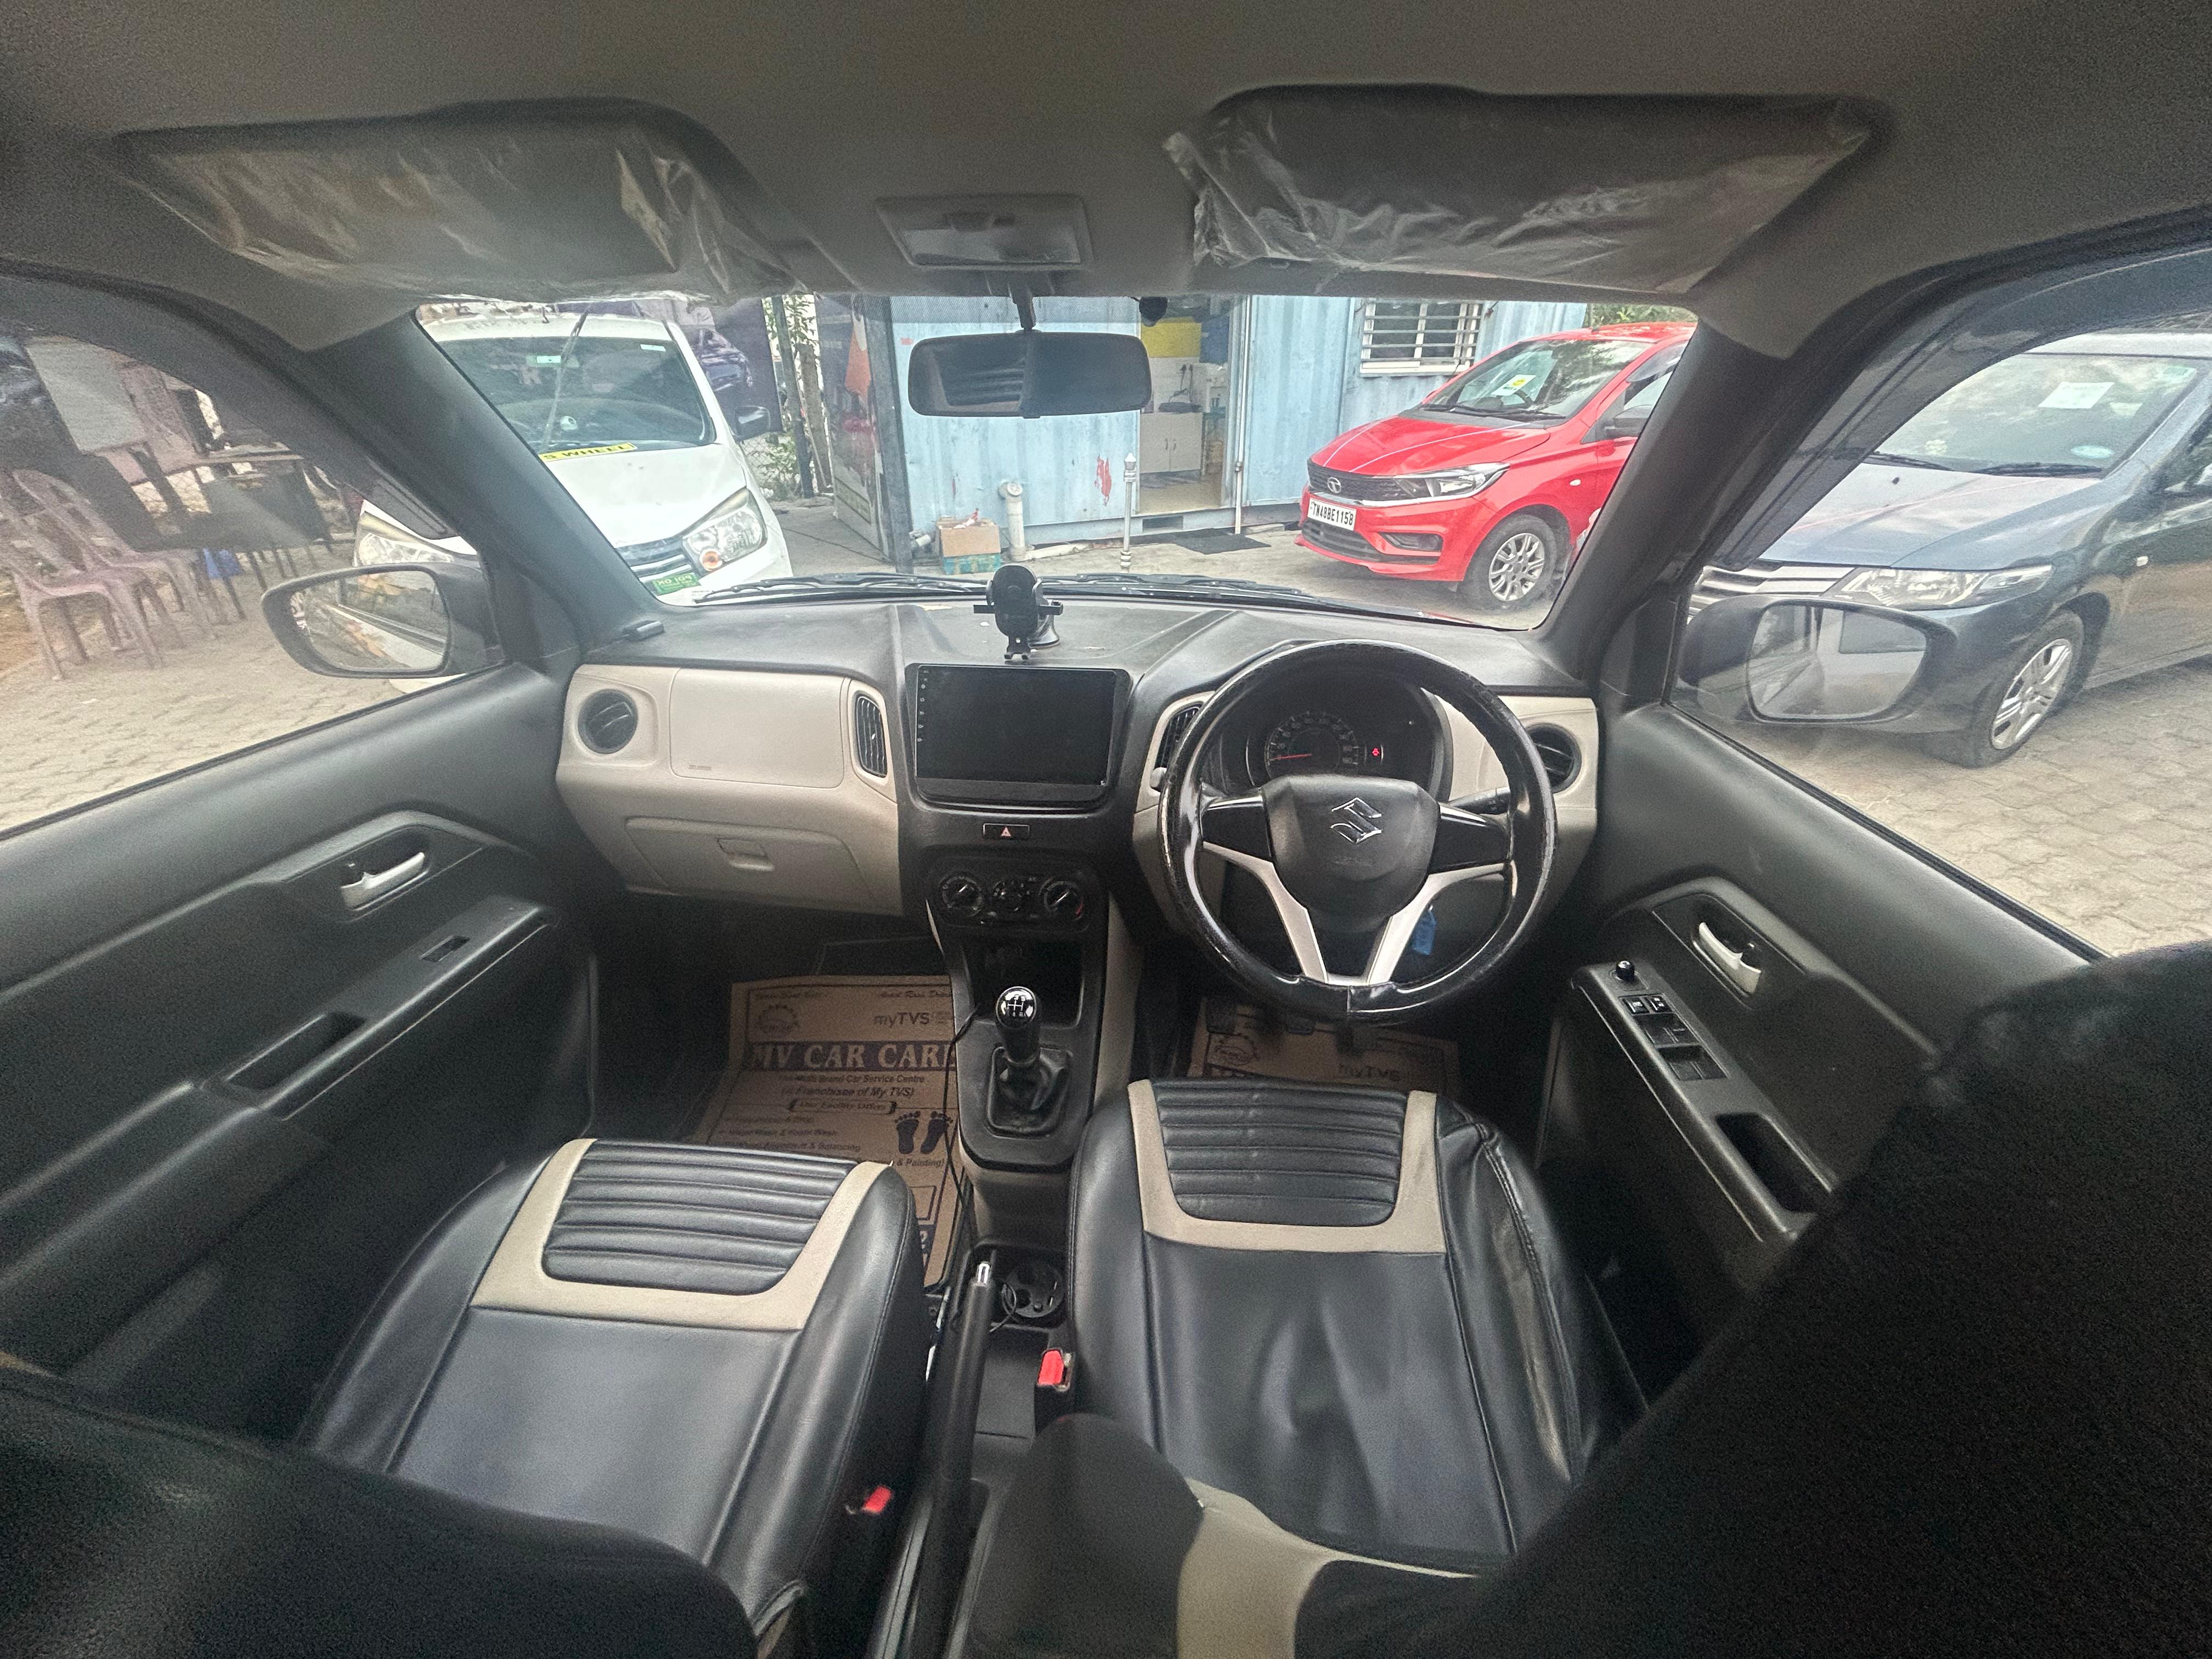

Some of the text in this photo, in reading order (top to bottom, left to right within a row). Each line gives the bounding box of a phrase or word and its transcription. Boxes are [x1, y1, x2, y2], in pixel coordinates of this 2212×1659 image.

[562, 445, 630, 456] WHEEL
[1313, 503, 1354, 526] TN48BE1158
[873, 1012, 930, 1028] myTVS
[804, 1043, 866, 1068] CAR
[847, 1075, 861, 1083] Car
[864, 1075, 895, 1083] Service
